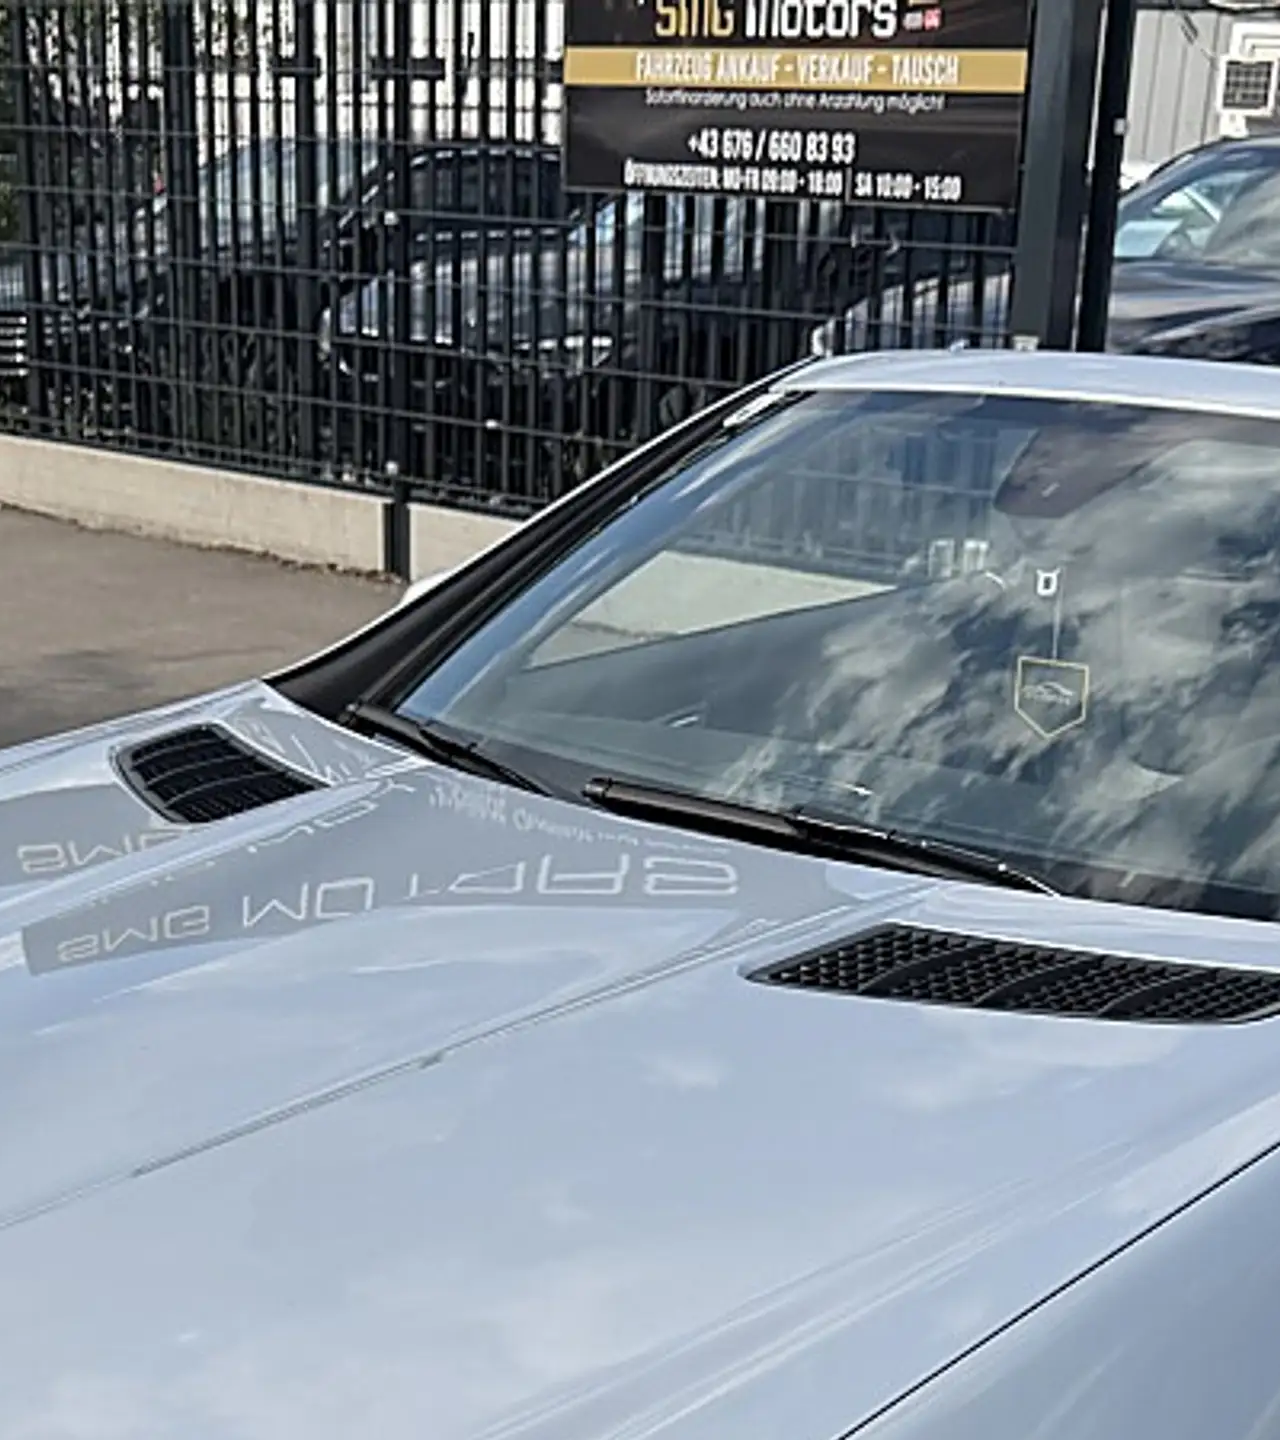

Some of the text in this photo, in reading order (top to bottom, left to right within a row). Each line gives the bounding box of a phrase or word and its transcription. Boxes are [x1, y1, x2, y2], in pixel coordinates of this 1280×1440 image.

[635, 51, 712, 82] FAHRZEUG
[717, 52, 781, 83] ANKAUF
[796, 53, 874, 85] VERKAUF
[892, 54, 959, 86] TAUSCH
[688, 127, 718, 159] +43
[805, 130, 829, 163] 83
[831, 131, 856, 165] 93
